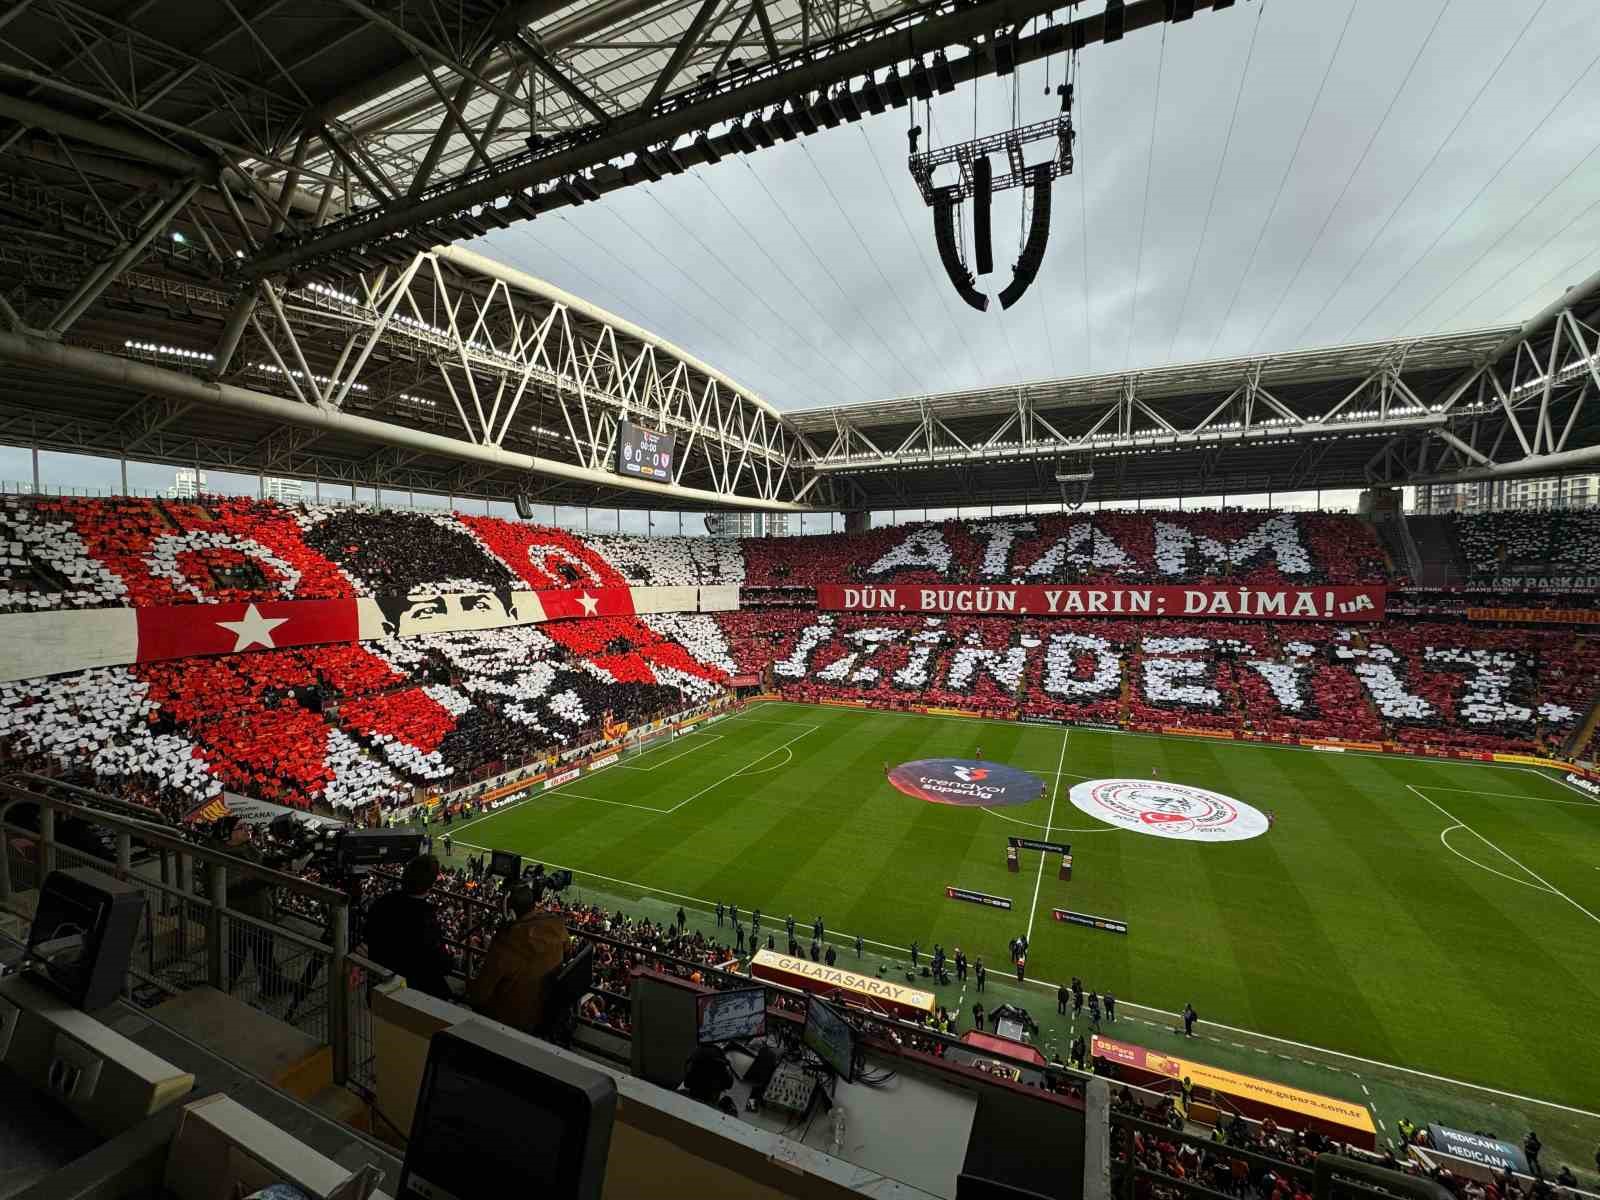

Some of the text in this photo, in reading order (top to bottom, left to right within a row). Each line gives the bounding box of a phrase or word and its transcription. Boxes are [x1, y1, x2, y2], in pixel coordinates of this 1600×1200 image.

[867, 513, 1312, 577] ATAM
[1184, 587, 1335, 618] DAİMA!
[919, 776, 1006, 794] trendyol
[778, 958, 905, 999] GALATASARAY
[1441, 1129, 1505, 1153] MEDICANA
[1447, 1144, 1510, 1167] MEDICANA
